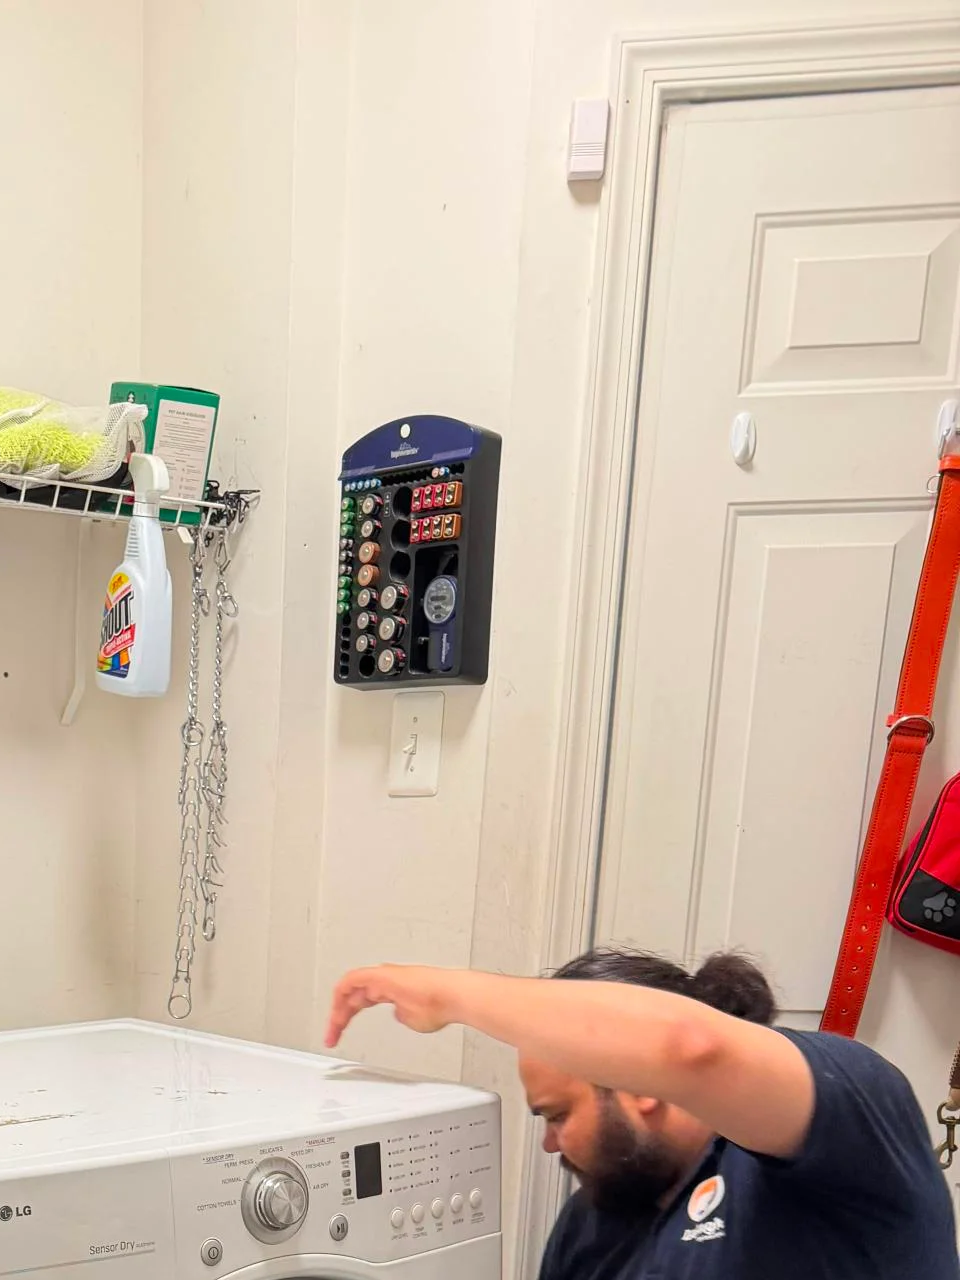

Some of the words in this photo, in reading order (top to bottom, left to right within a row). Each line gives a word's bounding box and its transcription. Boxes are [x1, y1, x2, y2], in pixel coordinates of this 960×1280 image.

[221, 1177, 241, 1185] NORMAL
[16, 1206, 32, 1217] LG
[90, 1243, 119, 1255] Sensor
[120, 1240, 135, 1252] Dry
